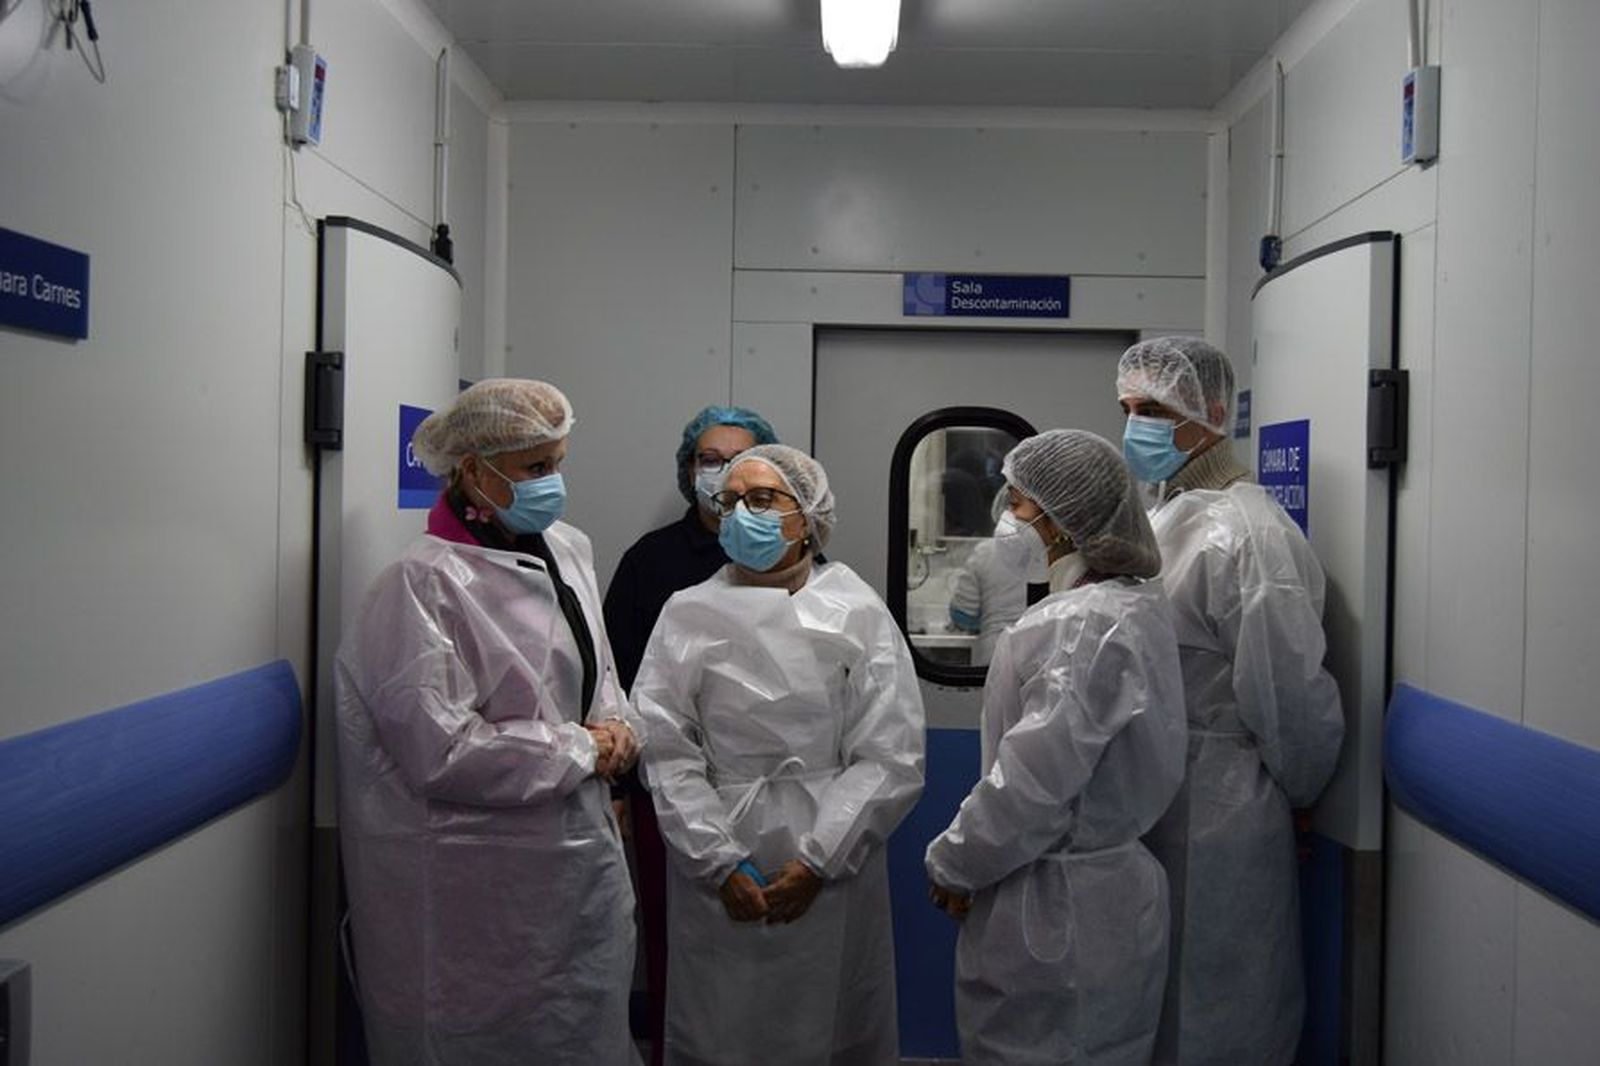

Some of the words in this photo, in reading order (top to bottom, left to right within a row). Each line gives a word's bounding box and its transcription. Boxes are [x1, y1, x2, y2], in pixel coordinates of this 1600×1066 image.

[32, 274, 81, 309] Carnes
[951, 281, 983, 294] Sala
[951, 296, 1062, 311] Descontaminación
[1260, 441, 1287, 473] CÁMARA
[1288, 446, 1301, 472] DE
